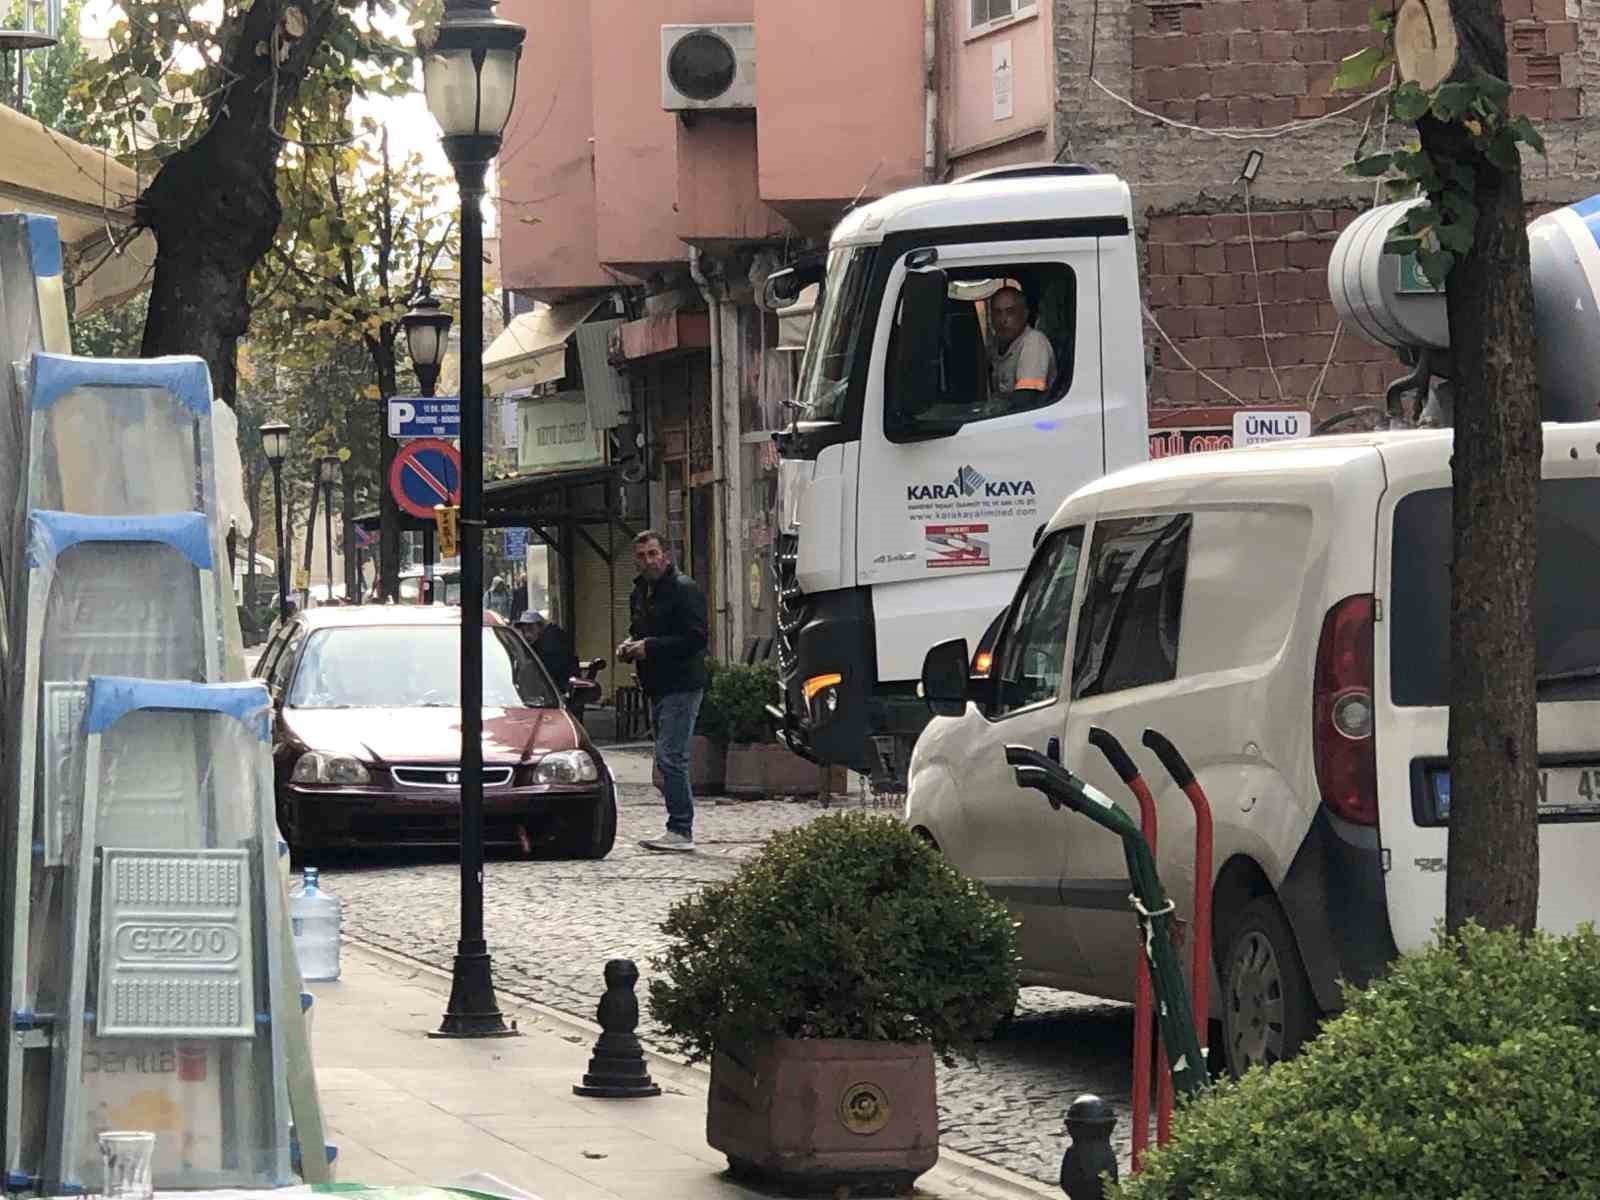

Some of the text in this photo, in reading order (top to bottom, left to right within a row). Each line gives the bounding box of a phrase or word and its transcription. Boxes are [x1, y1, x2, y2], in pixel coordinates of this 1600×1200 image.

[391, 402, 415, 434] P
[1245, 415, 1298, 435] ÜNLÜ
[1149, 431, 1184, 459] NLÜ
[907, 480, 1036, 501] KARA KAYA
